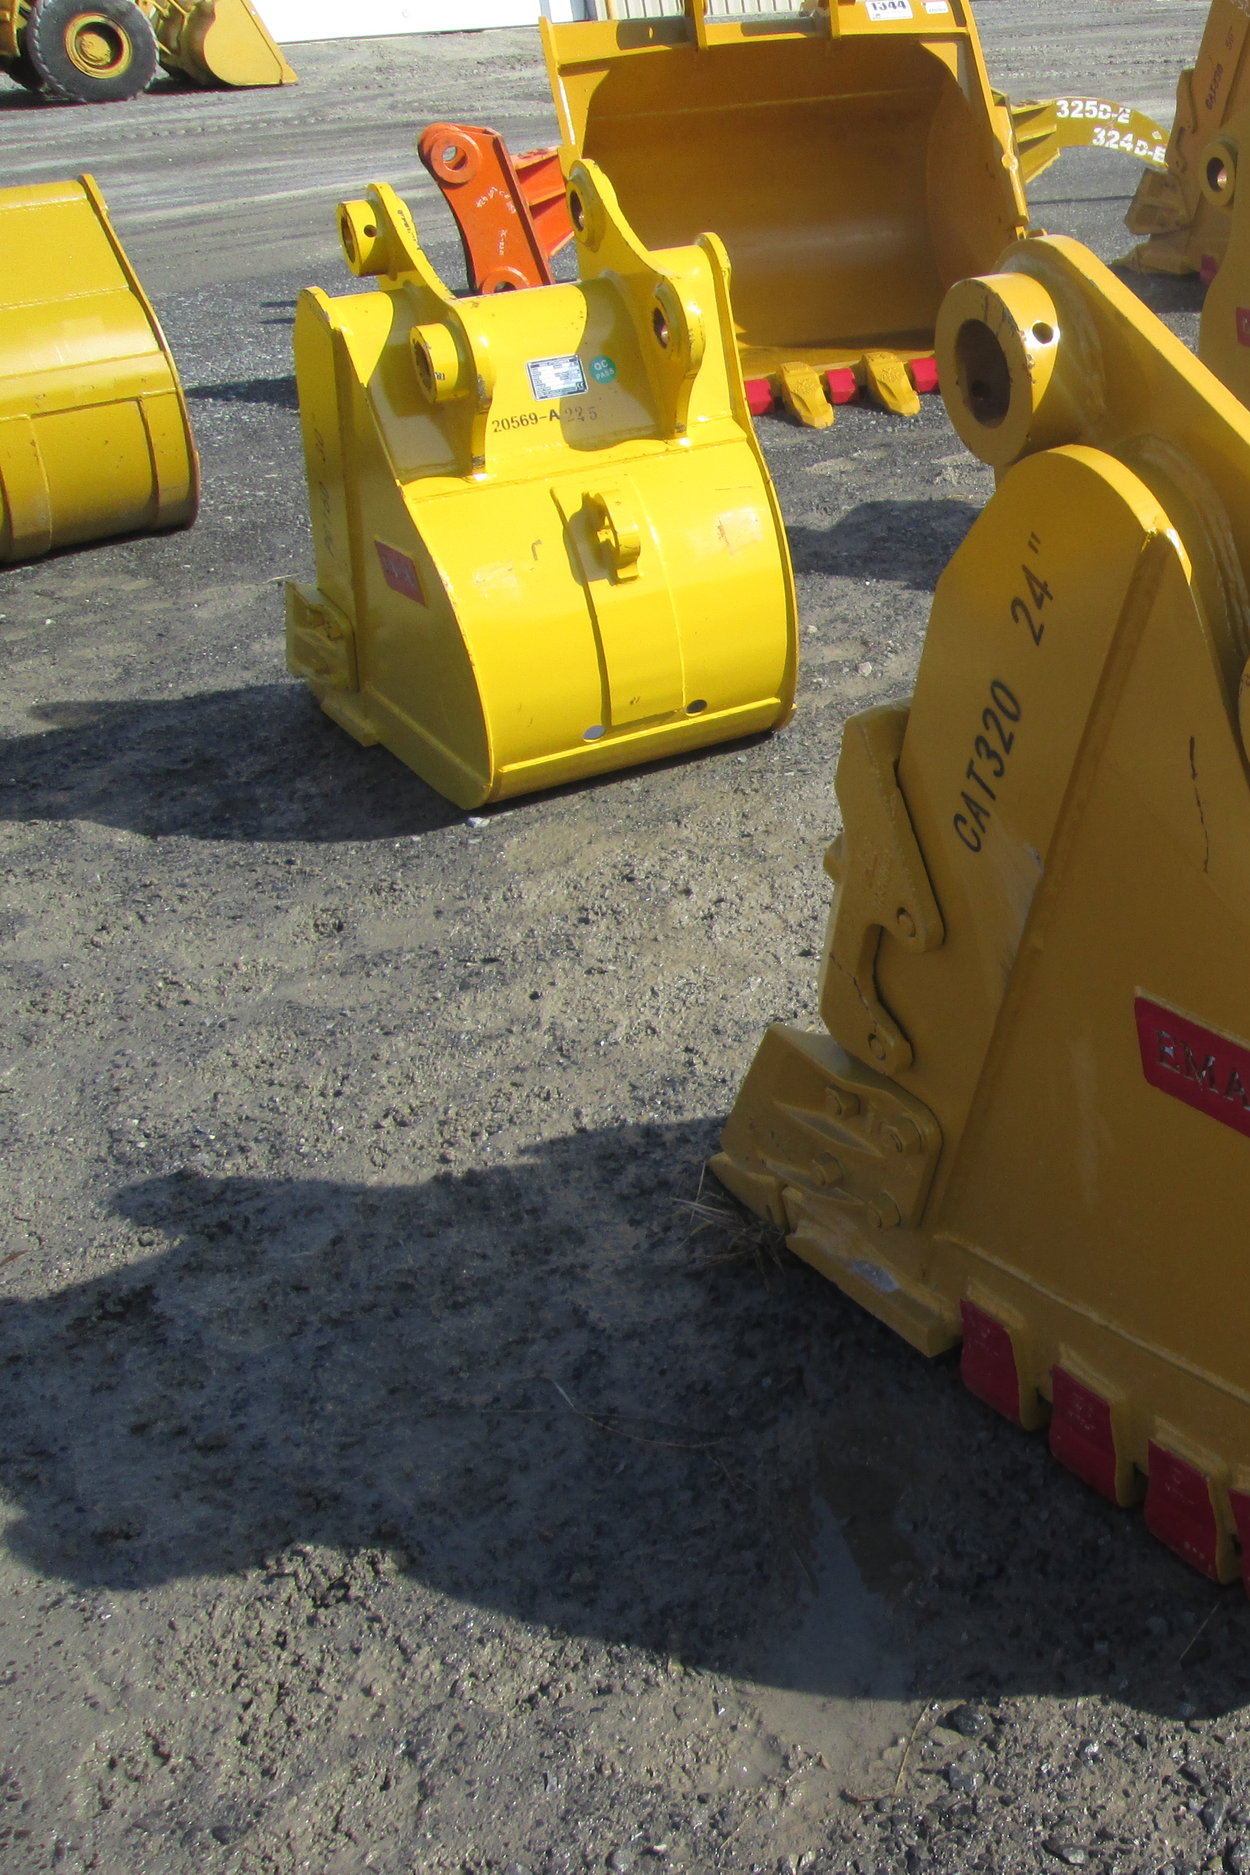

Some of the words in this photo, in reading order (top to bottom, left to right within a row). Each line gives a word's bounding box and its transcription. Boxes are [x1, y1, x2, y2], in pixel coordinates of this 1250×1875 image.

[1056, 99, 1132, 124] 325D-E
[1091, 127, 1167, 163] 324D-E
[594, 359, 608, 371] QC
[491, 409, 560, 433] 20569-A
[953, 679, 1022, 853] CAT320
[1010, 531, 1054, 647] 24"
